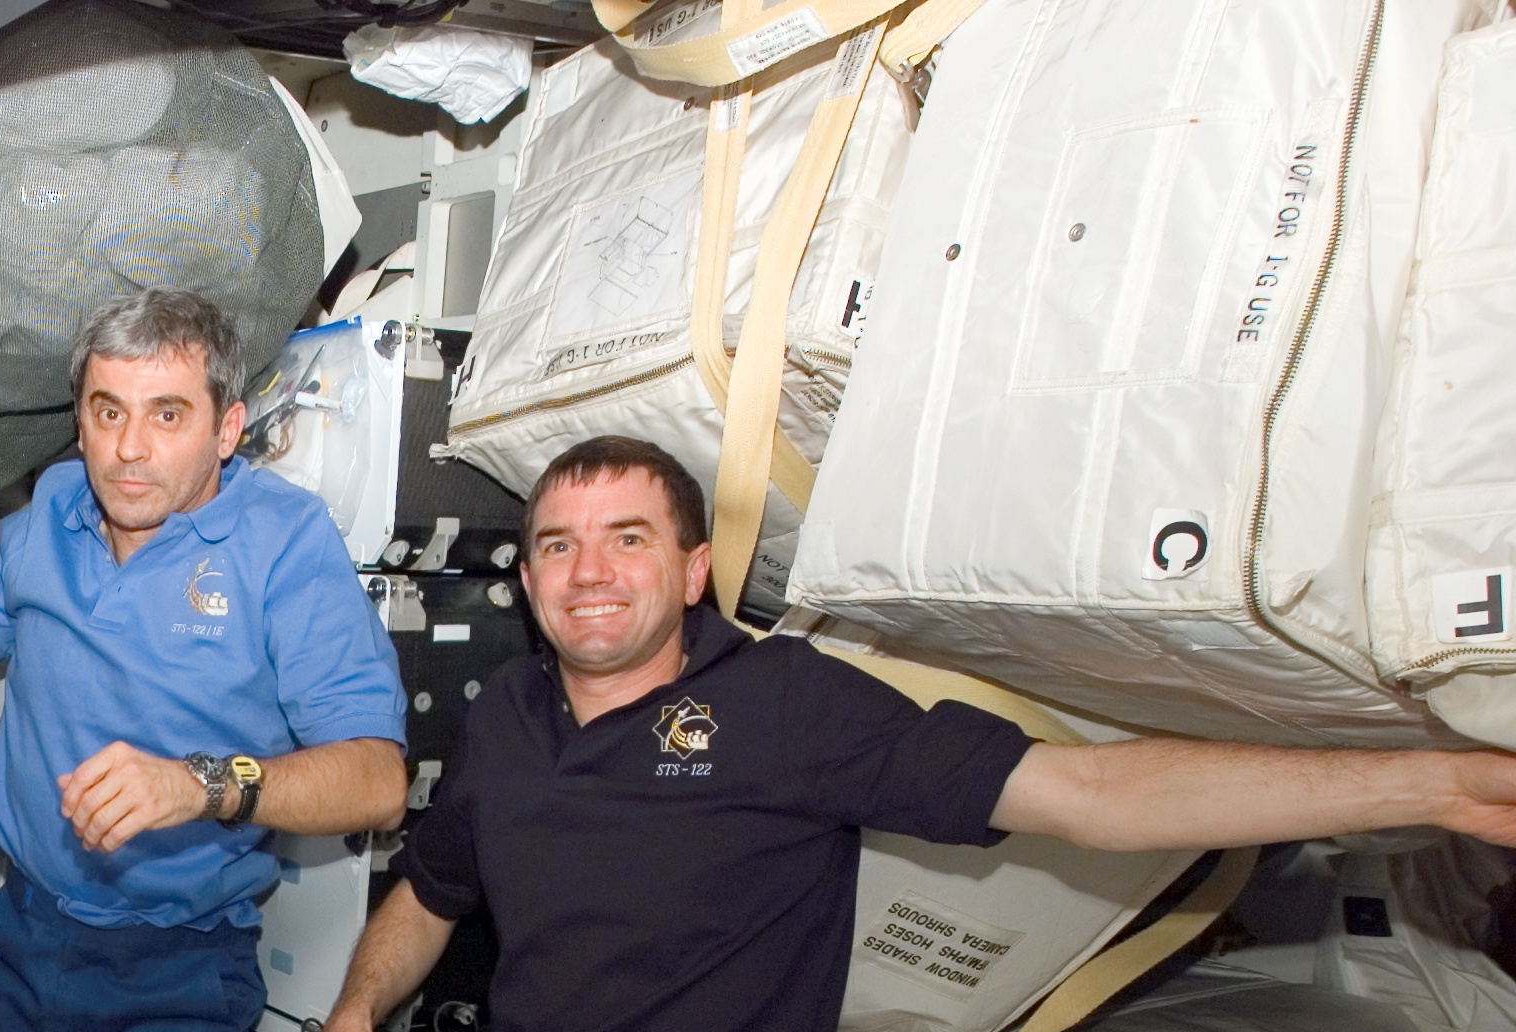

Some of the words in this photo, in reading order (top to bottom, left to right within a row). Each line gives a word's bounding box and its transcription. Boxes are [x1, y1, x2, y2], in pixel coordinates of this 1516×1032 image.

[1287, 145, 1317, 188] NOT
[1274, 191, 1306, 238] FOR
[1237, 297, 1271, 343] USE
[596, 338, 624, 356] FOR
[1153, 520, 1208, 573] C
[757, 554, 790, 572] NOT
[1454, 574, 1504, 638] F
[655, 762, 713, 777] STS-122
[887, 902, 957, 938] SHROUDS
[862, 936, 923, 966] SHADES
[883, 922, 935, 951] HOSES
[961, 932, 1012, 957] CAMERA
[924, 962, 981, 988] WINDOW
